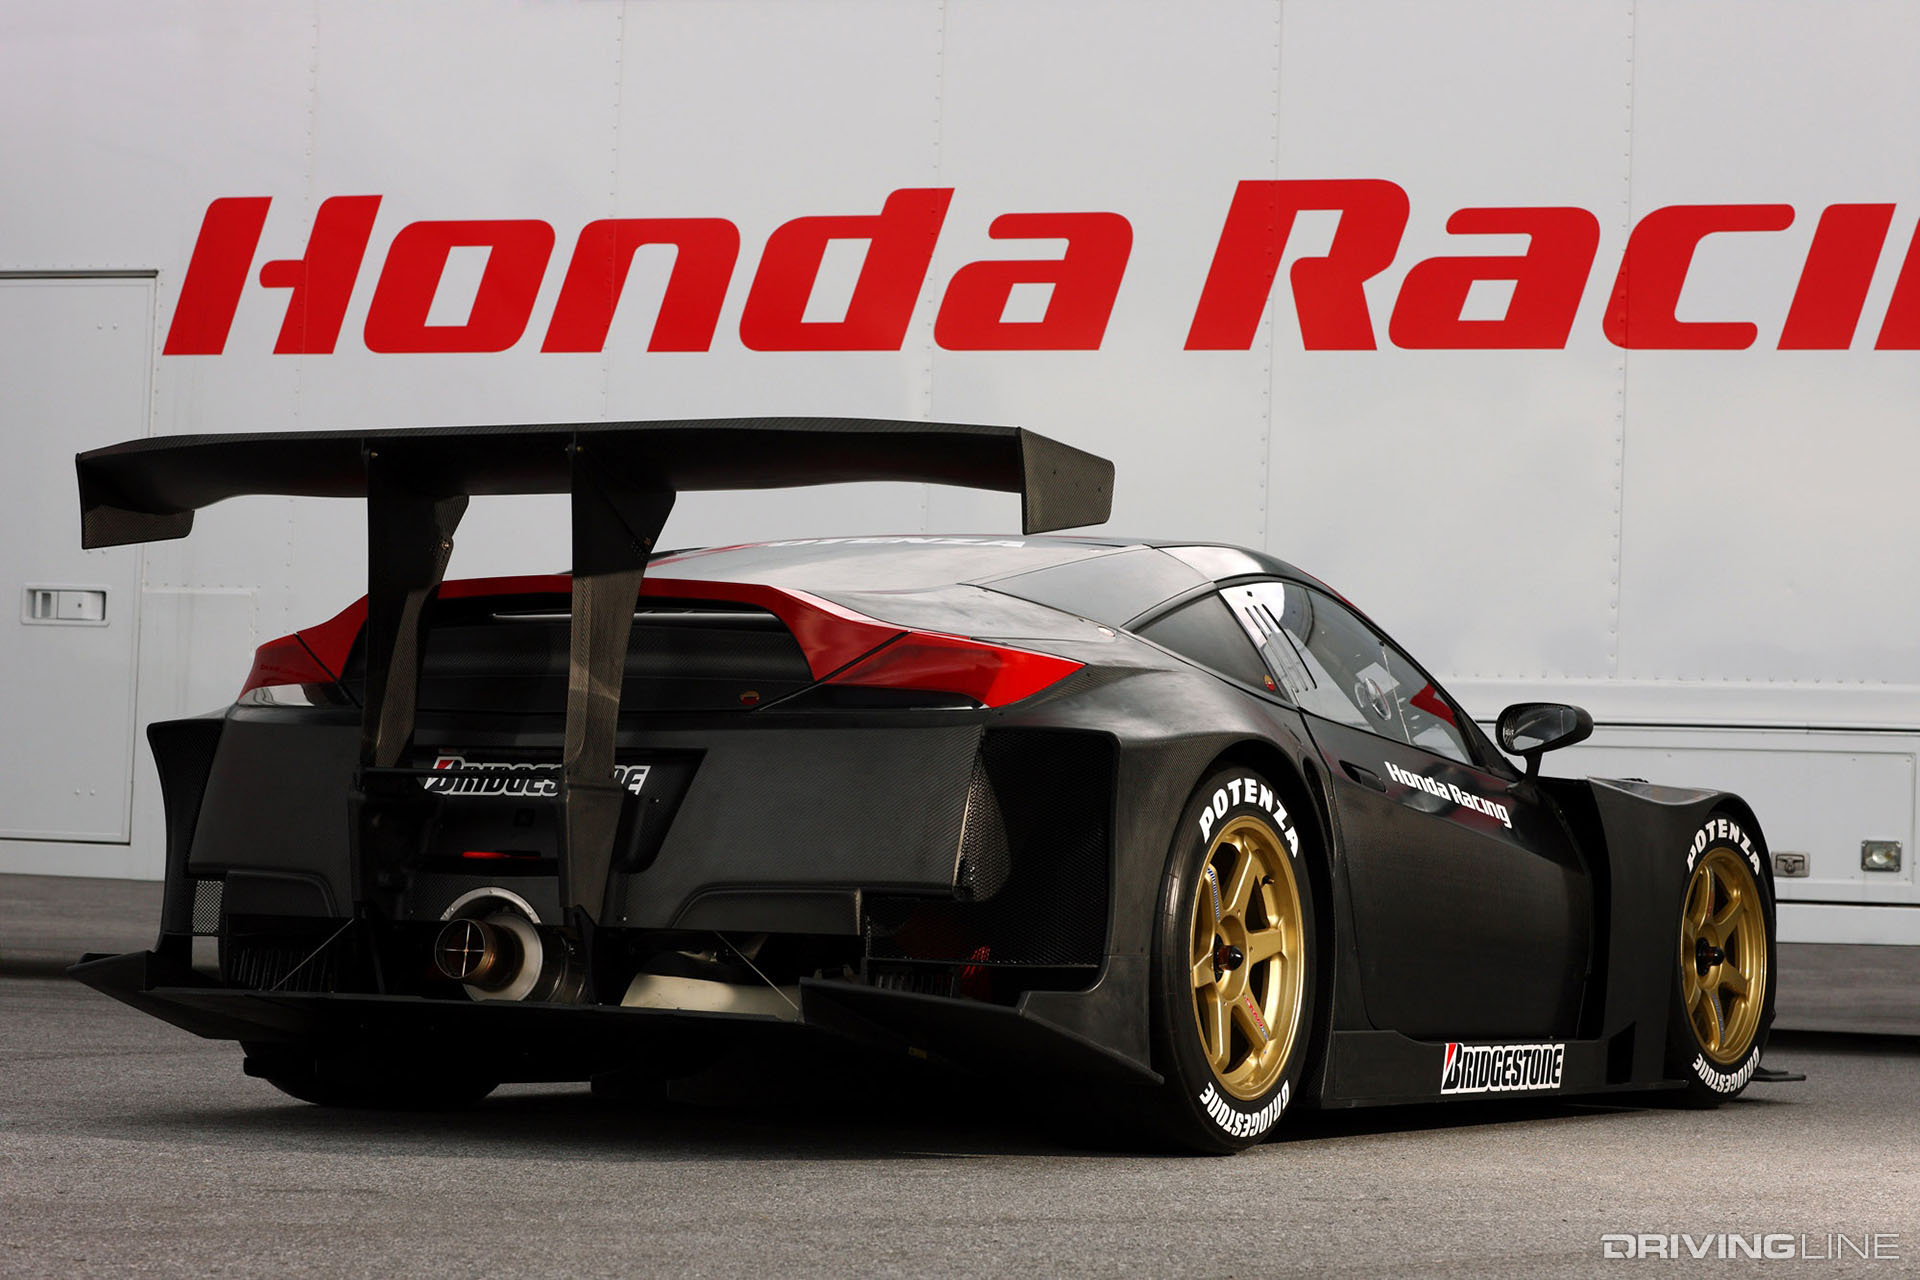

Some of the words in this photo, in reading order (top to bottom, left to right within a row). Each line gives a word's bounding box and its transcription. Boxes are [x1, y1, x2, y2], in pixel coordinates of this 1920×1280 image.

[163, 188, 1133, 355] Honda
[1184, 179, 1920, 350] Raci
[1199, 778, 1299, 858] POTENZA
[1384, 761, 1452, 801] Honda
[1447, 783, 1513, 829] Racing
[1687, 818, 1760, 876] POTENZA
[1441, 1042, 1565, 1094] BRIDGESTONE
[1692, 1045, 1760, 1094] BRIDGESTONE
[1199, 1079, 1290, 1138] BRIDGESTONE
